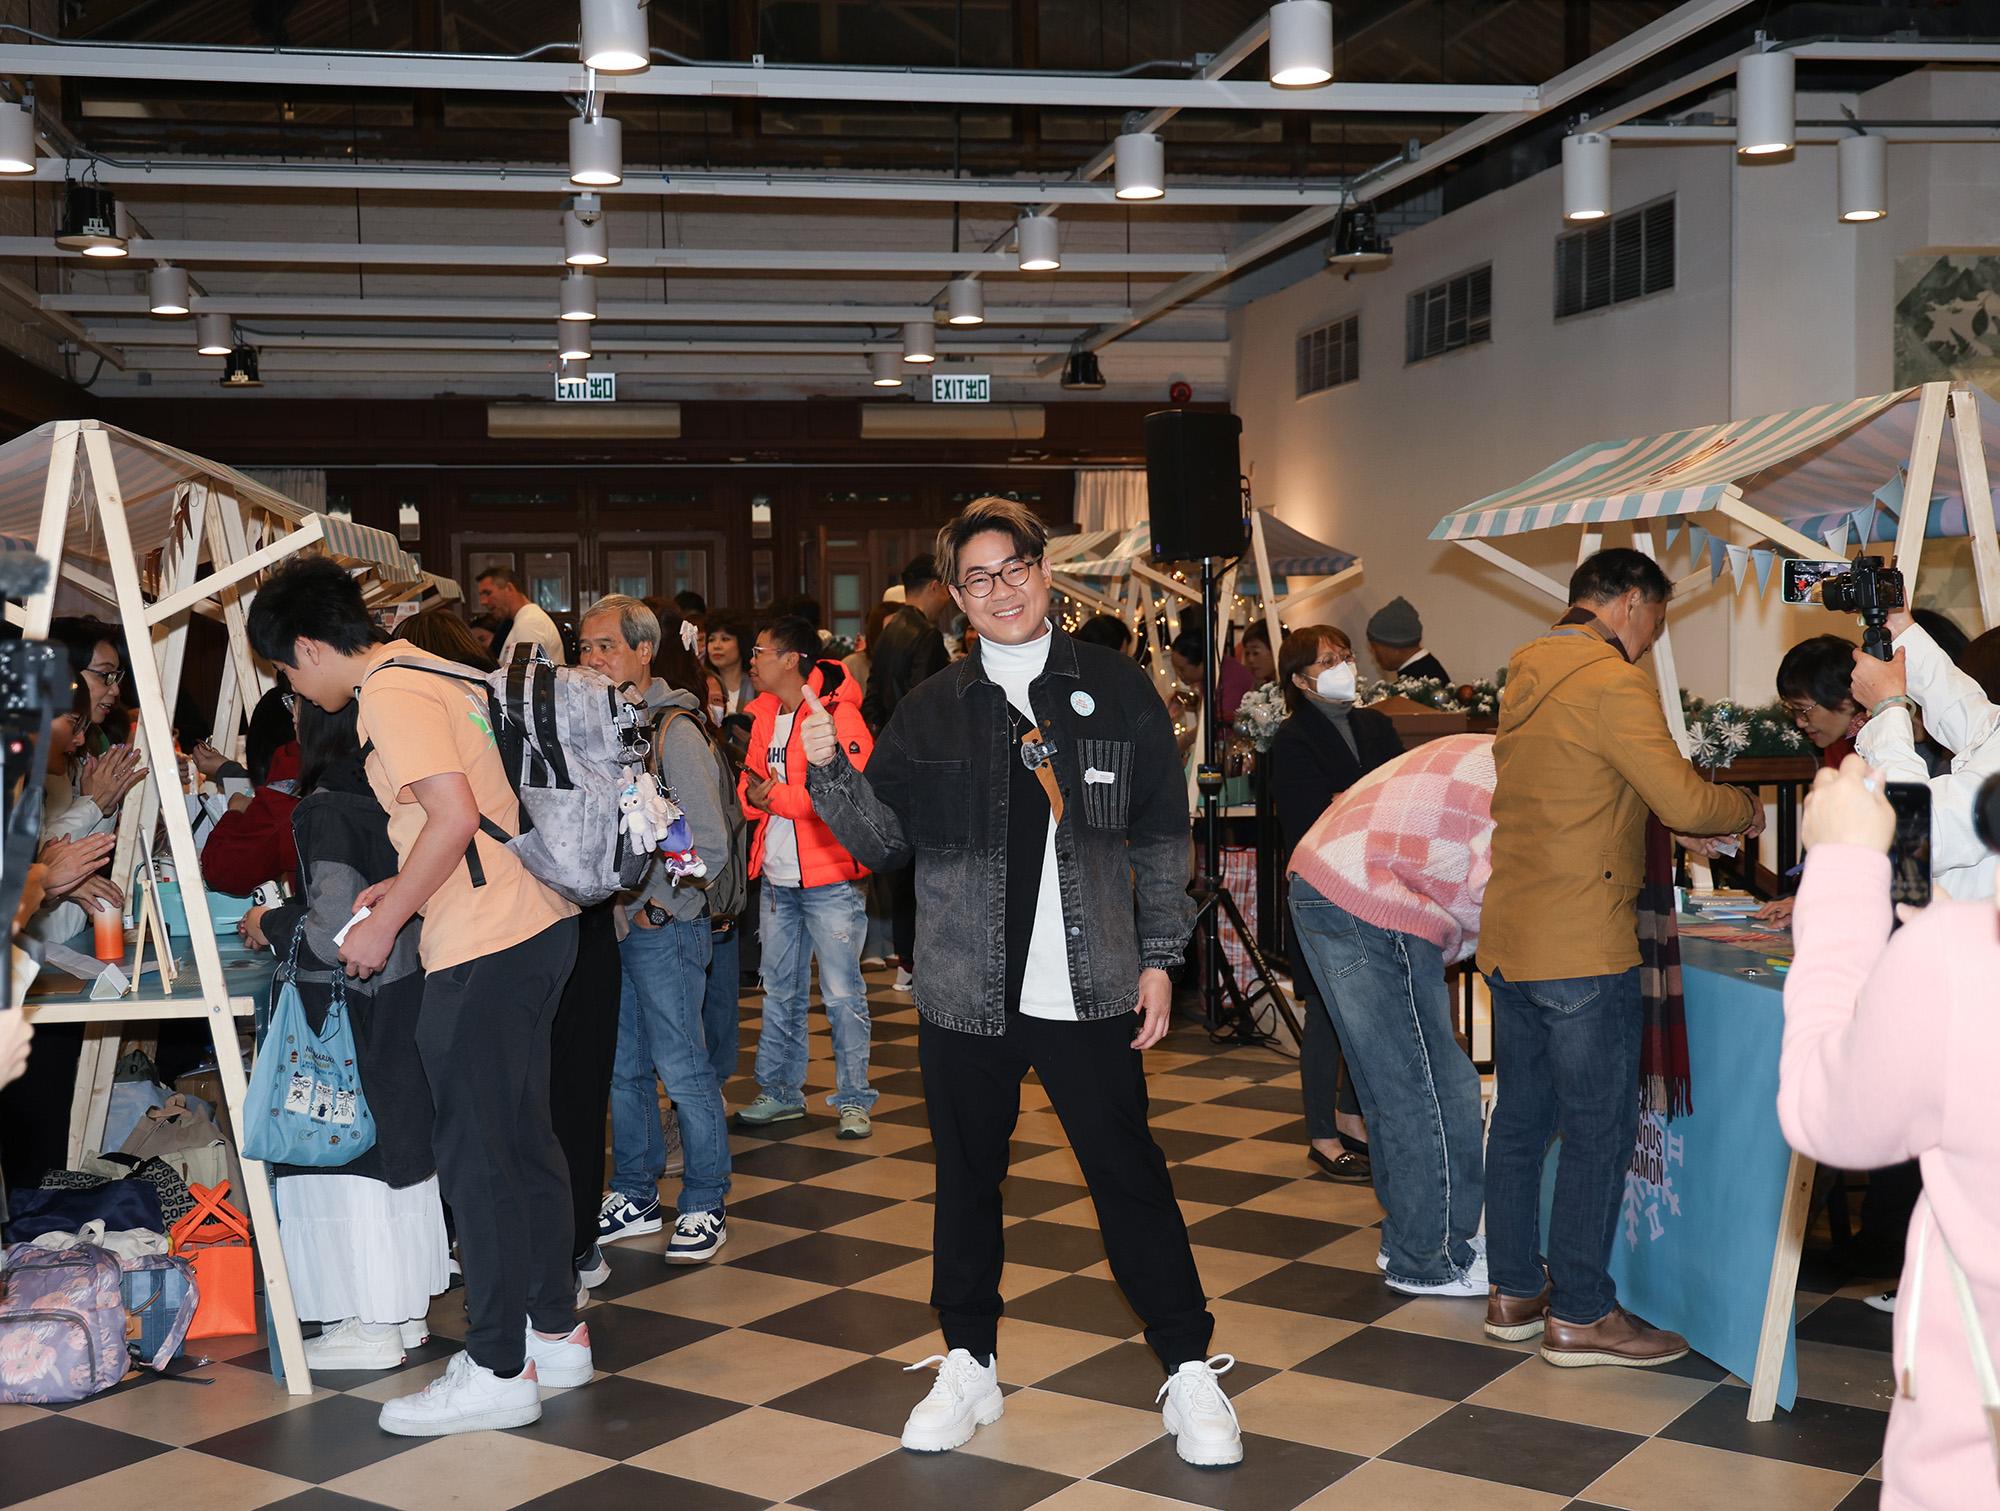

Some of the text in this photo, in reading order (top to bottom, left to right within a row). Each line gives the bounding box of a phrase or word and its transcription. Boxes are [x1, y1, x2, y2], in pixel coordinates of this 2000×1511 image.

[590, 377, 613, 399] 出口
[935, 379, 987, 400] EXIT 出口
